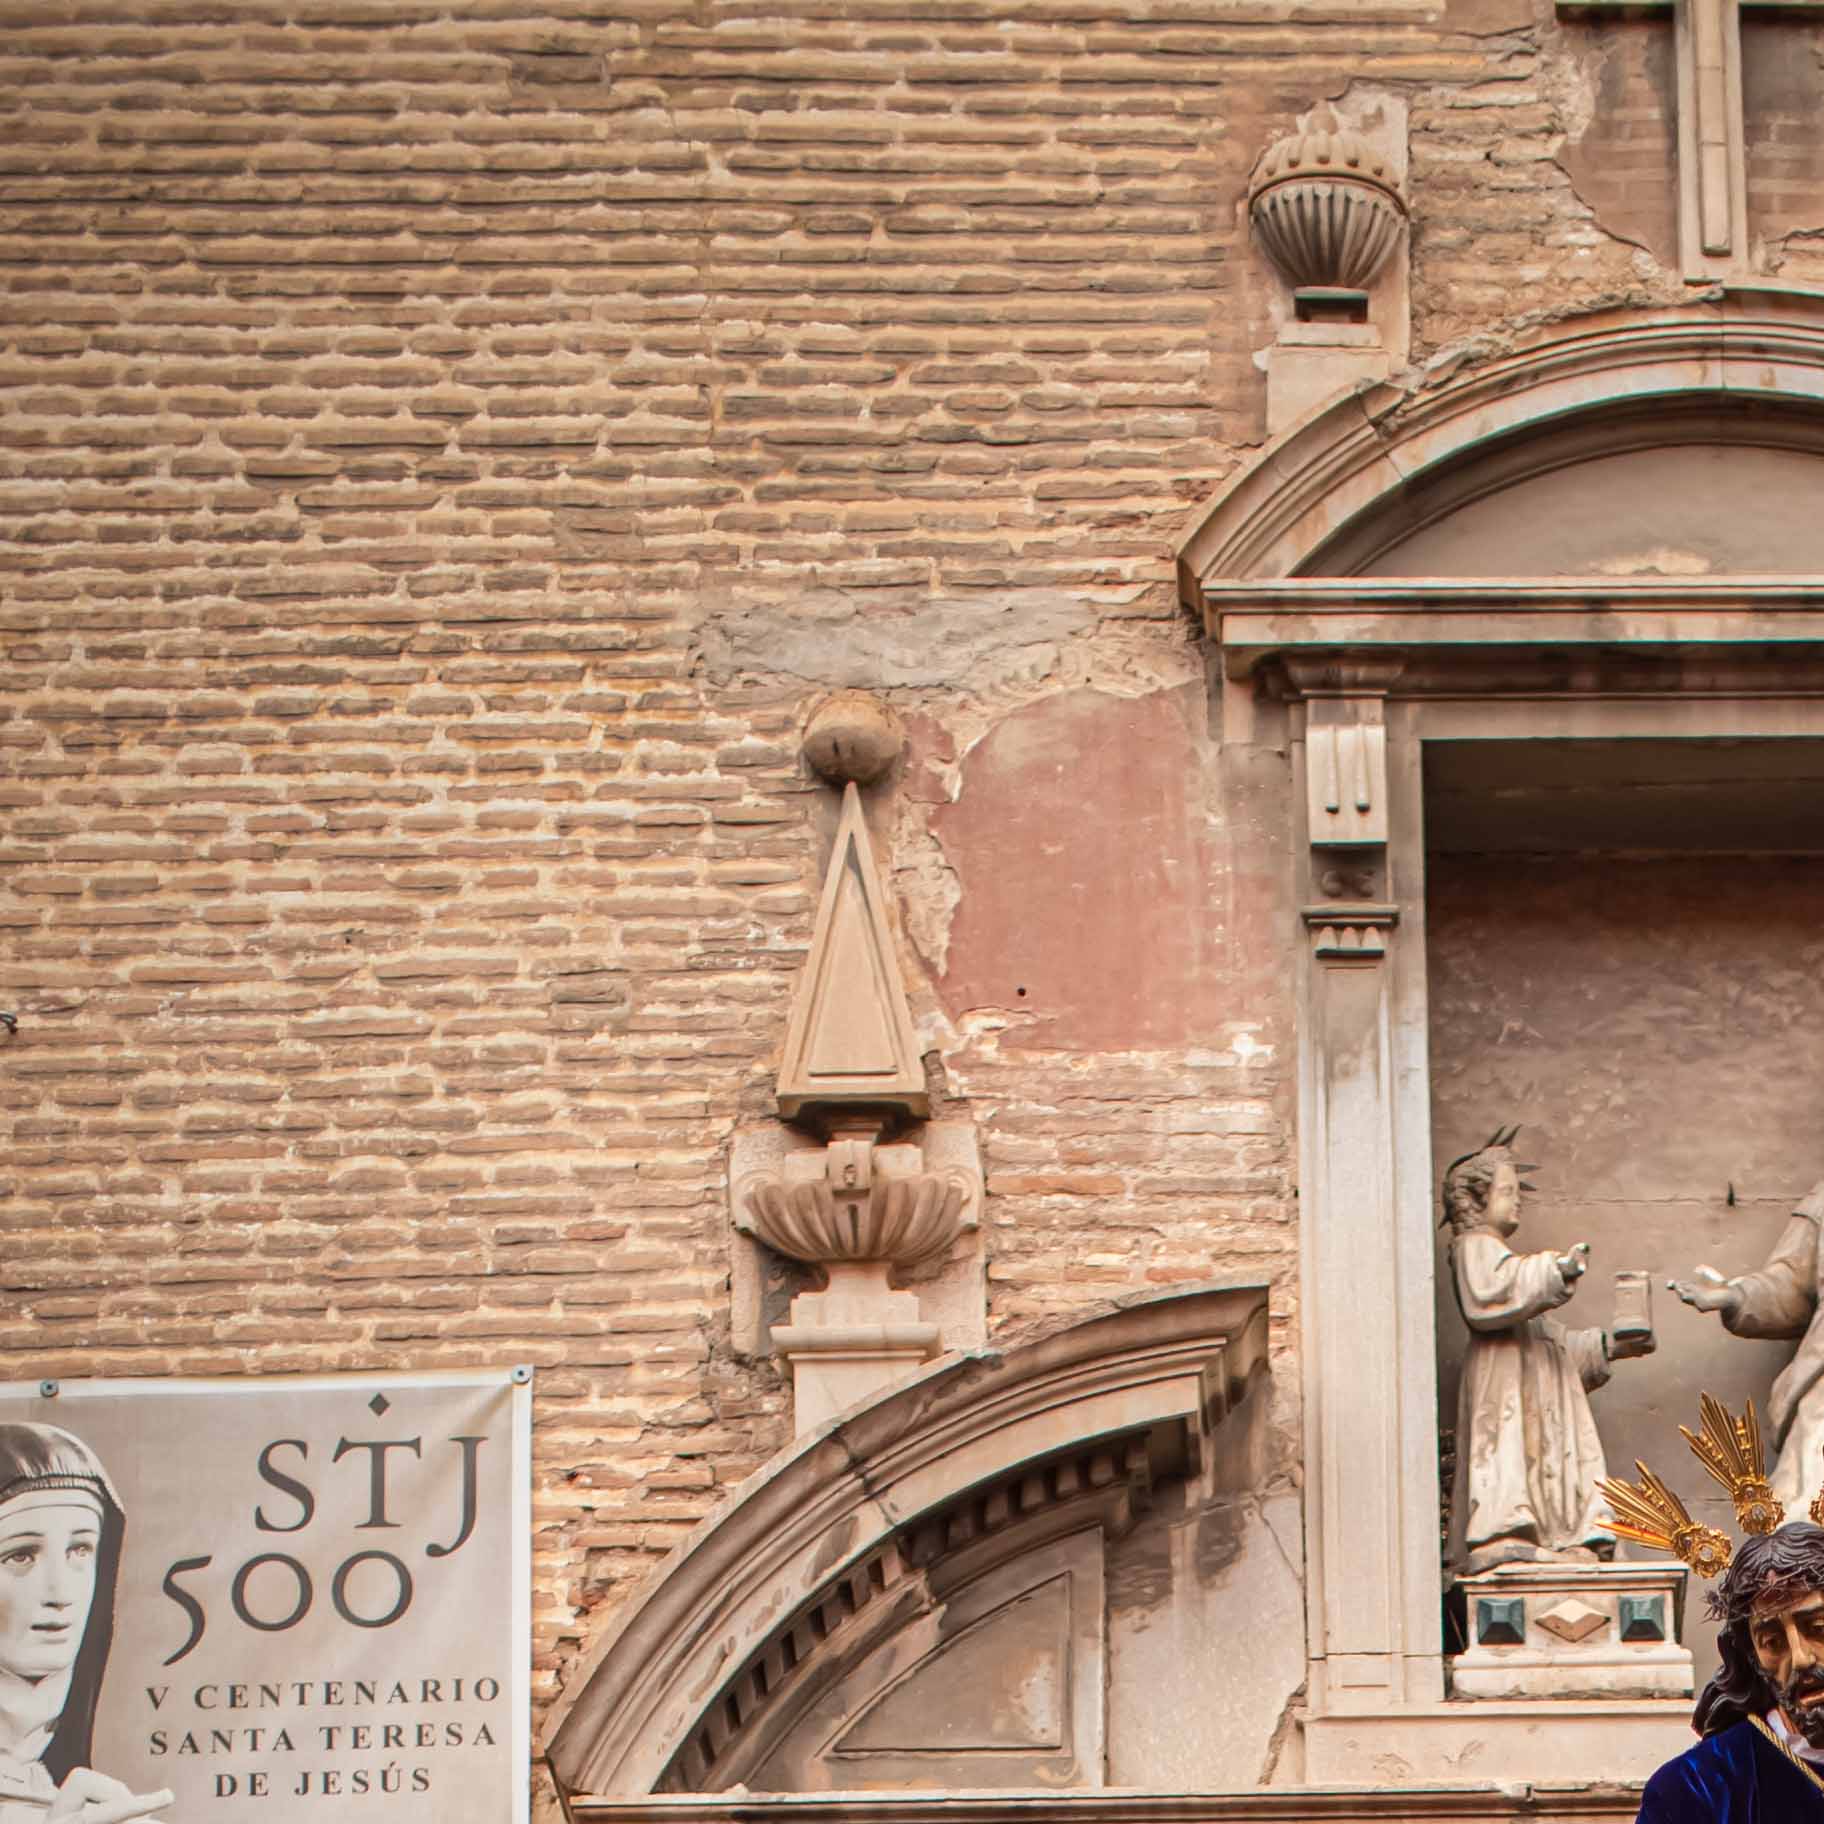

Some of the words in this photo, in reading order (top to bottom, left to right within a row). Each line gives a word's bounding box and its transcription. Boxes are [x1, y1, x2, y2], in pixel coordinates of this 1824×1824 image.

[254, 1435, 489, 1558] STJ
[162, 1549, 414, 1667] 500
[145, 1686, 170, 1711] V
[193, 1677, 500, 1710] CENTENARIO
[149, 1727, 296, 1756] SANTA
[319, 1722, 497, 1751] TERESA
[215, 1772, 270, 1798] DE
[294, 1760, 431, 1797] JESÚS
